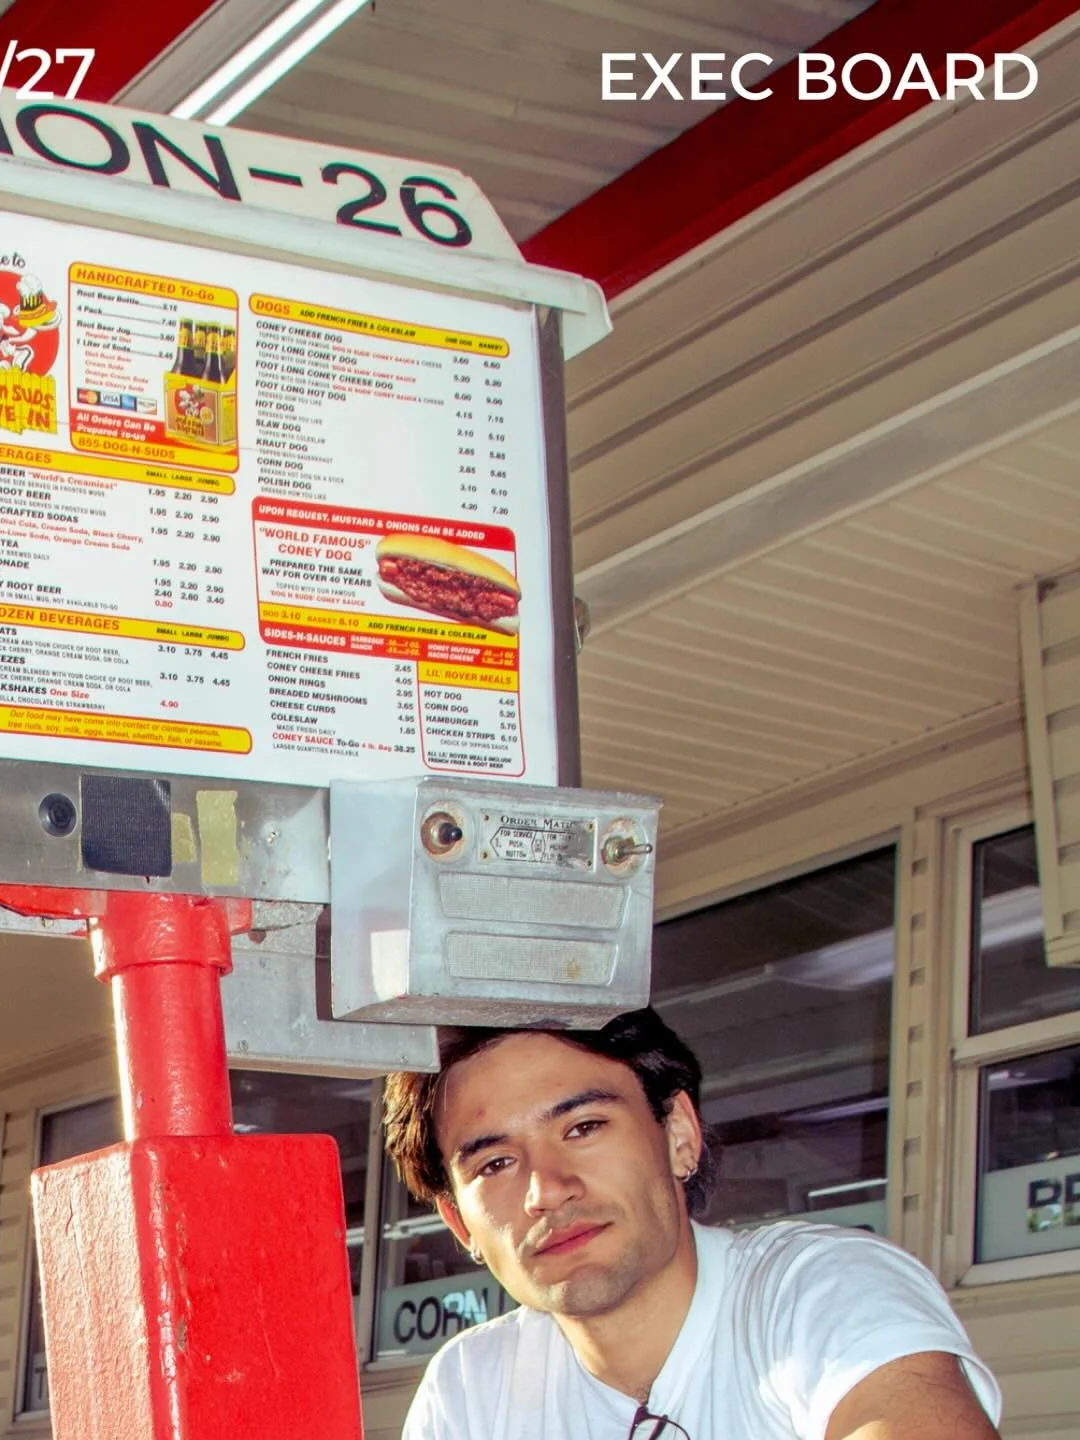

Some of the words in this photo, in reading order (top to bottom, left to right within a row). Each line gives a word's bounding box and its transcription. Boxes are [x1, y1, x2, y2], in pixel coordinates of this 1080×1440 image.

[11, 252, 26, 269] to
[77, 269, 176, 294] HANDCRAFTED
[180, 286, 215, 301] To-Go
[256, 300, 291, 315] DOGS
[256, 320, 286, 332] CONEY
[288, 327, 321, 339] CHEESE
[324, 333, 342, 343] DOG
[12, 384, 54, 410] SUDS
[255, 379, 278, 390] FOOT
[280, 385, 305, 394] LONG
[306, 388, 325, 398] HOT
[327, 391, 346, 401] DOG
[255, 399, 273, 408] HOT
[275, 402, 294, 412] DOG
[26, 409, 51, 429] IN
[78, 437, 175, 459] 855-DOG-N-SUDS
[256, 457, 282, 467] CORN
[284, 460, 303, 470] DOG
[0, 466, 25, 477] BEER
[28, 472, 64, 482] "World's
[67, 476, 116, 489] Creamiest"
[148, 487, 165, 497] 1.95
[174, 491, 192, 500] 2.20
[200, 495, 218, 504] 2.90
[47, 512, 78, 523] SODAS
[1, 538, 18, 548] TEA
[278, 543, 321, 557] CONEY
[325, 549, 352, 561] DOG
[270, 559, 315, 571] PREPARED
[318, 564, 334, 573] THE
[338, 567, 362, 576] SAME
[39, 611, 119, 630] BEVERAGES
[264, 627, 346, 646] SIDES-N-SAUCES
[266, 649, 301, 660] FRENCH
[303, 653, 328, 663] FRIES
[266, 661, 297, 672] CONEY
[299, 665, 332, 676] CHEESE
[335, 670, 360, 679] FRIES
[426, 669, 443, 678] LIL'
[444, 670, 477, 680] ROVER
[479, 674, 511, 685] MEALS
[49, 688, 67, 696] One
[71, 690, 89, 698] Size
[269, 687, 309, 698] BREADED
[311, 692, 367, 705] MUSHROOMS
[424, 702, 448, 711] CORN
[450, 704, 468, 713] DOG
[270, 712, 318, 724] COLESLAW
[425, 715, 478, 726] HAMBURGER
[272, 732, 302, 741] CONEY
[305, 735, 333, 745] SAUCE
[336, 738, 359, 747] To-Go
[500, 816, 537, 826] ORDER
[393, 1287, 489, 1343] CORN
